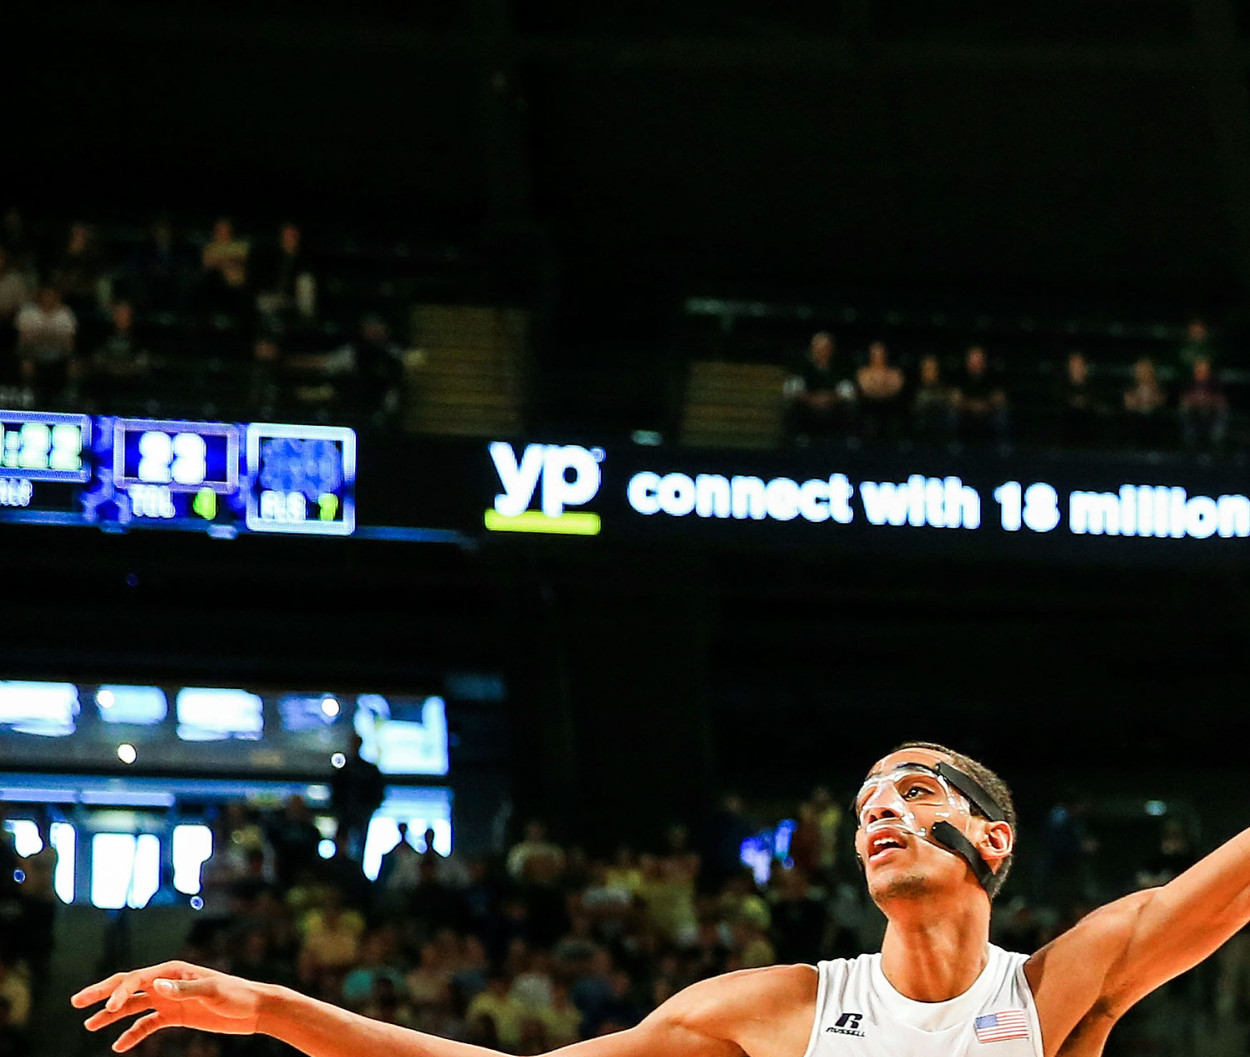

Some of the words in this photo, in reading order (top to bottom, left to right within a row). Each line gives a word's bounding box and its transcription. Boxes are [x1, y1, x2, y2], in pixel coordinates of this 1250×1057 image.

[489, 441, 599, 517] yp
[626, 471, 854, 524] connect
[859, 474, 981, 530] with
[994, 480, 1061, 532] 18
